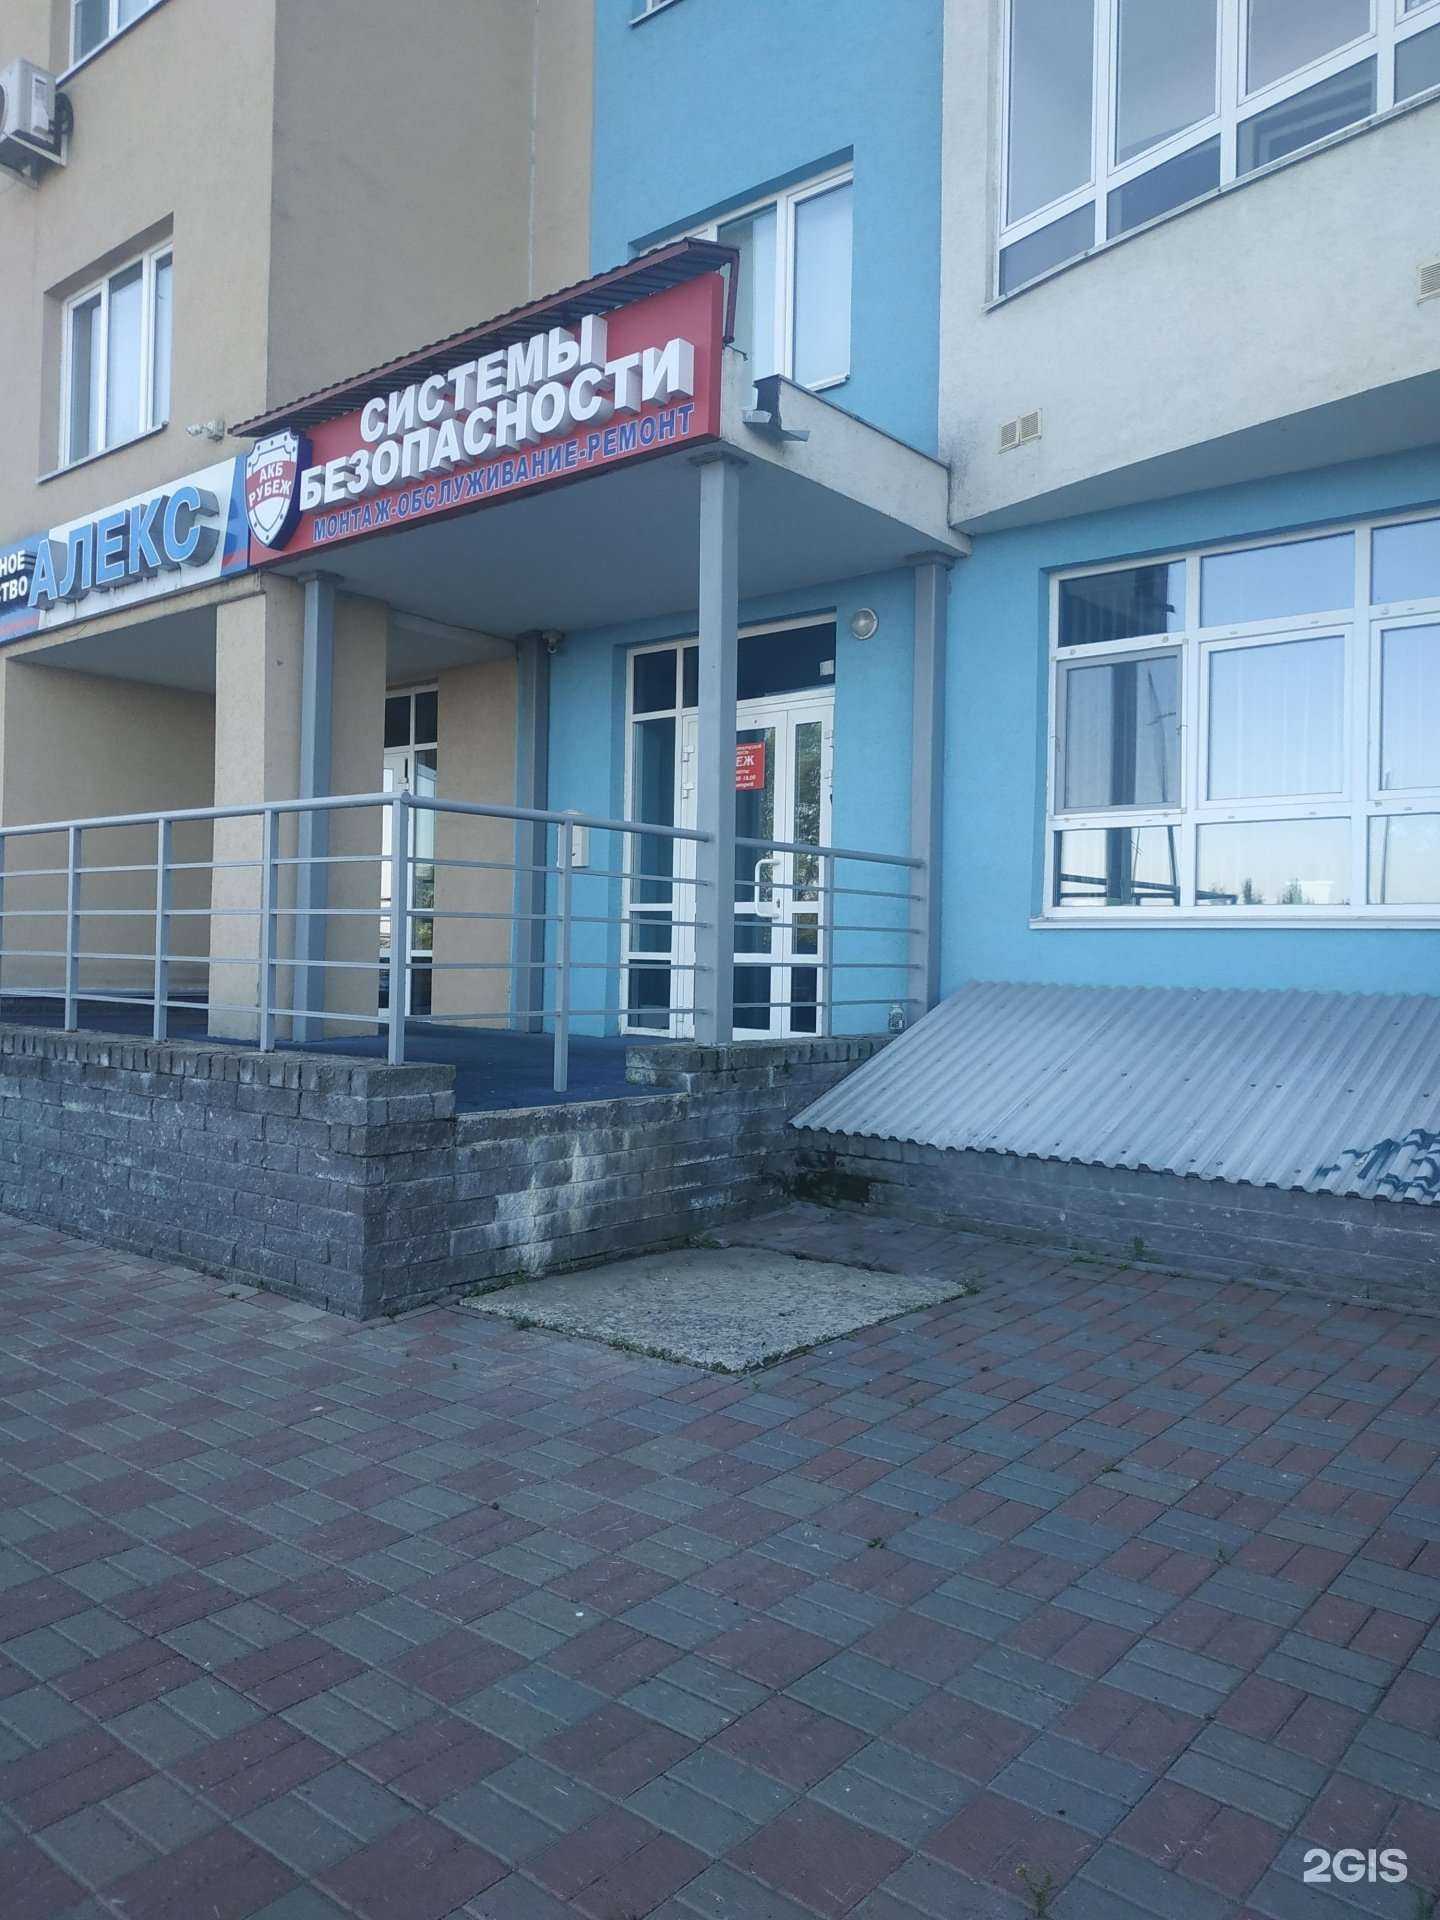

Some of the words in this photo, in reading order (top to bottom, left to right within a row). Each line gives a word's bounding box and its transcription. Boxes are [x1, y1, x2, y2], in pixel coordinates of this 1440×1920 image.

[360, 314, 605, 443] СИСТЕМЫ
[299, 338, 695, 512] БЕЗОПАСНОСТИ
[248, 479, 292, 508] РУБЕЖ
[259, 462, 283, 484] АКБ
[27, 486, 206, 607] АЛЕКС
[0, 576, 28, 602] ТВО
